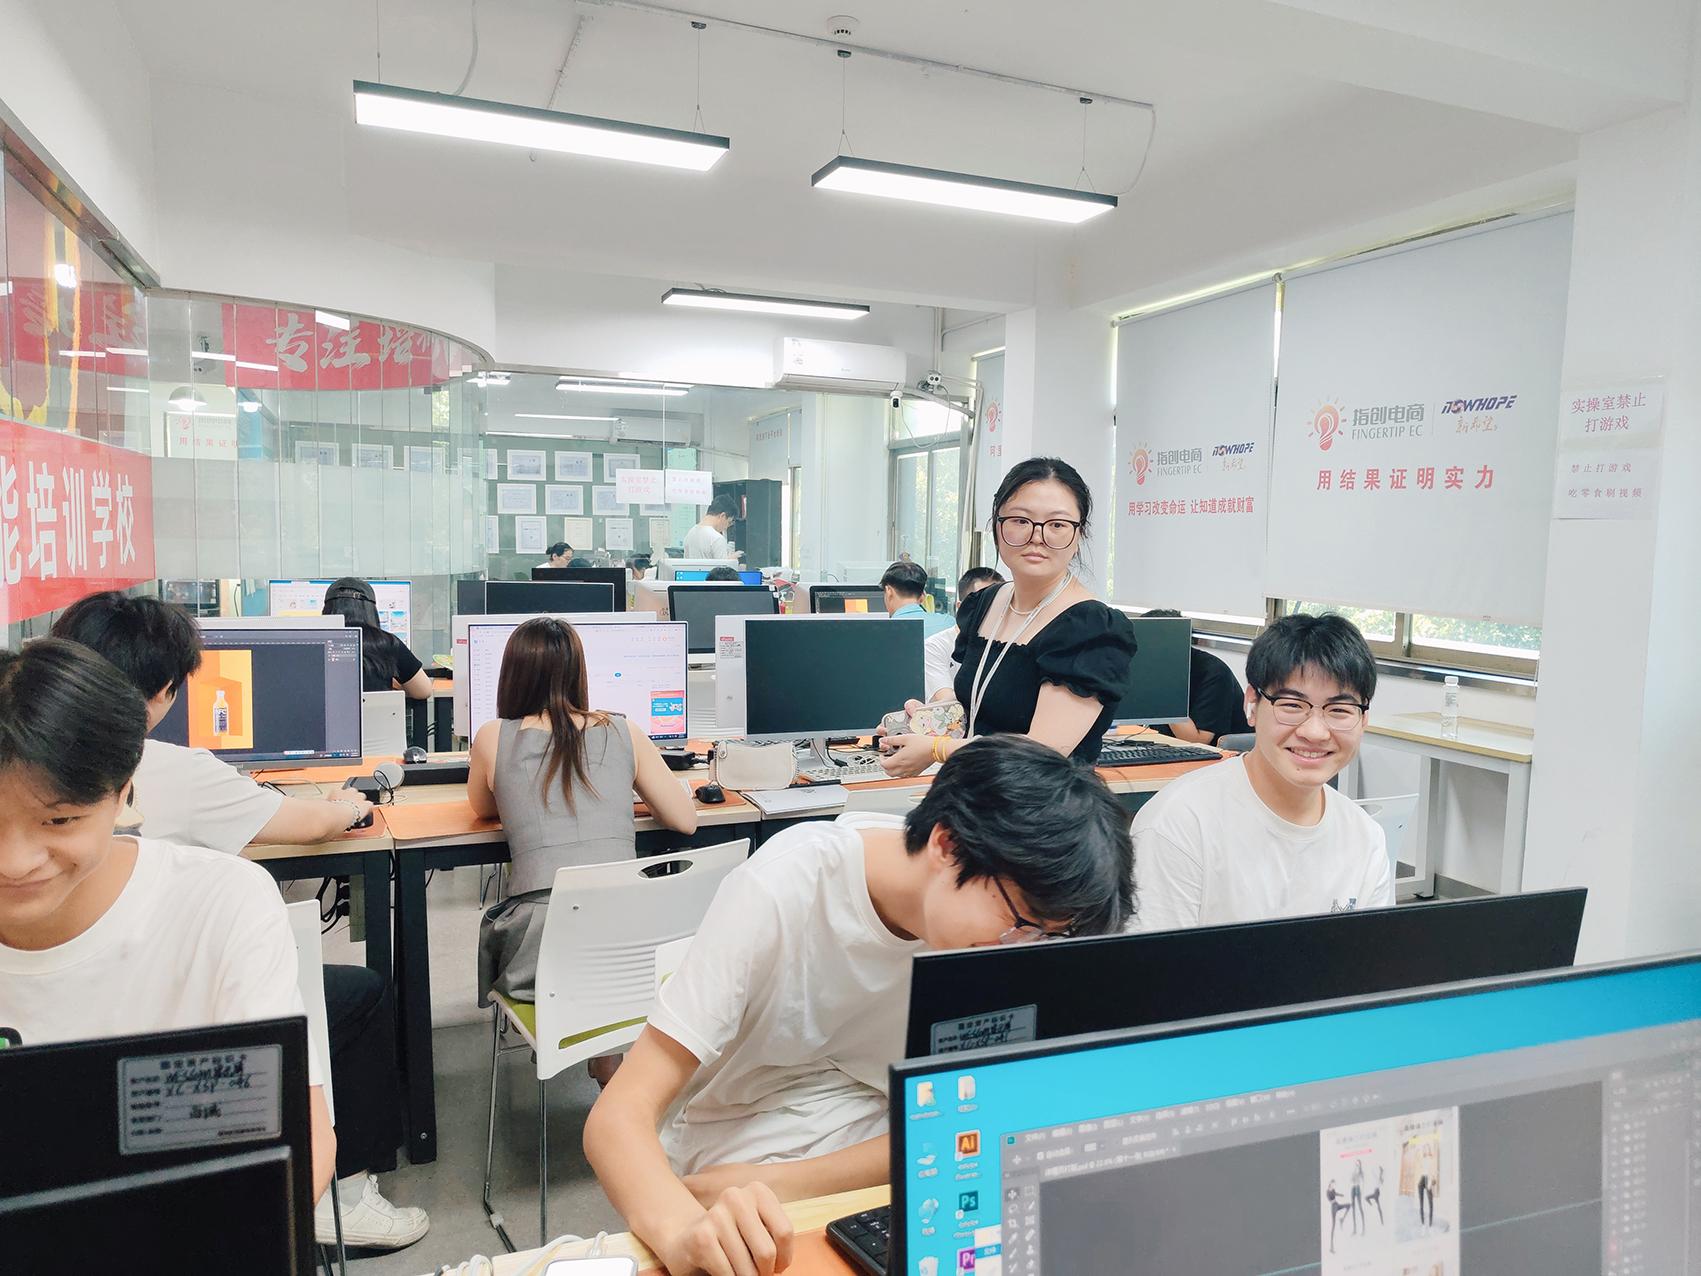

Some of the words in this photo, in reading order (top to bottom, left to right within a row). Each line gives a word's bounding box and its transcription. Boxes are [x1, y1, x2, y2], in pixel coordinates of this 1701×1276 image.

[1571, 392, 1646, 414] 实操室禁止
[1352, 403, 1425, 426] 指创电商
[1351, 427, 1405, 440] FINGERTIP
[1408, 425, 1424, 437] EC
[1585, 415, 1629, 433] 打游戏
[1157, 448, 1202, 466] 指创电商
[1316, 465, 1495, 491] 用结果证明实力
[1128, 500, 1186, 516] 用学习改变命运
[961, 1135, 975, 1151] Ai
[961, 1195, 976, 1207] Ps
